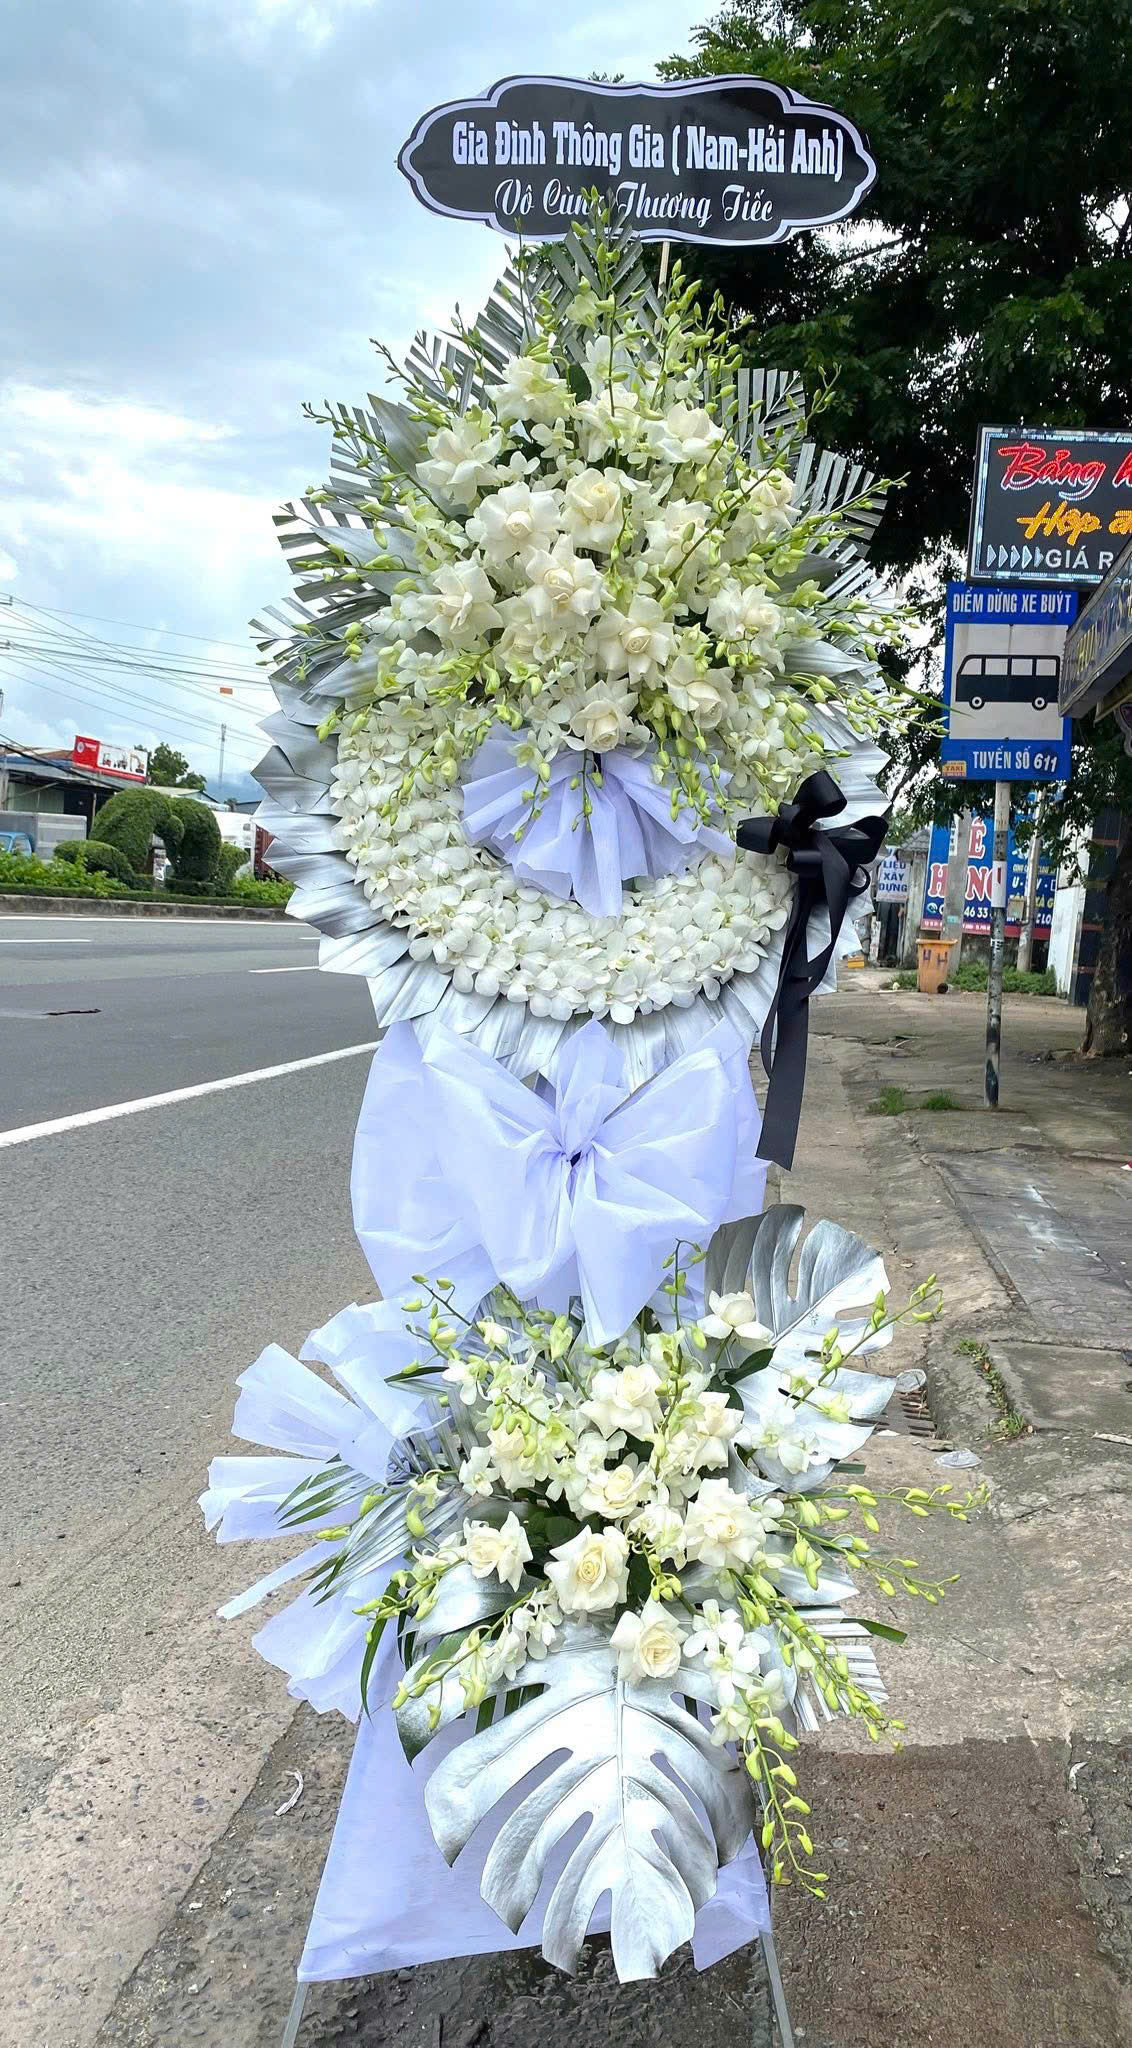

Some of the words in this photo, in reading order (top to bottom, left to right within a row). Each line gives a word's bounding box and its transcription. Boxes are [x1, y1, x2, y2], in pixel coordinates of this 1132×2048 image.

[453, 120, 489, 165] Gia
[495, 119, 546, 165] Đình
[553, 121, 622, 176] Thông
[629, 124, 665, 168] Gia
[791, 128, 844, 183] Anh)
[494, 178, 534, 216] Vô
[615, 181, 713, 228] Thương
[721, 184, 774, 222] Tiếc
[998, 442, 1107, 501] Bảng
[1045, 546, 1089, 569] GIÁ
[952, 586, 984, 613] ĐIỂM
[987, 588, 1018, 614] DỪNG
[1021, 593, 1037, 614] XE
[1040, 590, 1072, 614] BUÝT
[972, 745, 1012, 769] TUYẾN
[1015, 745, 1031, 770] SỐ
[1033, 753, 1058, 773] 611
[883, 871, 905, 881] XÂY
